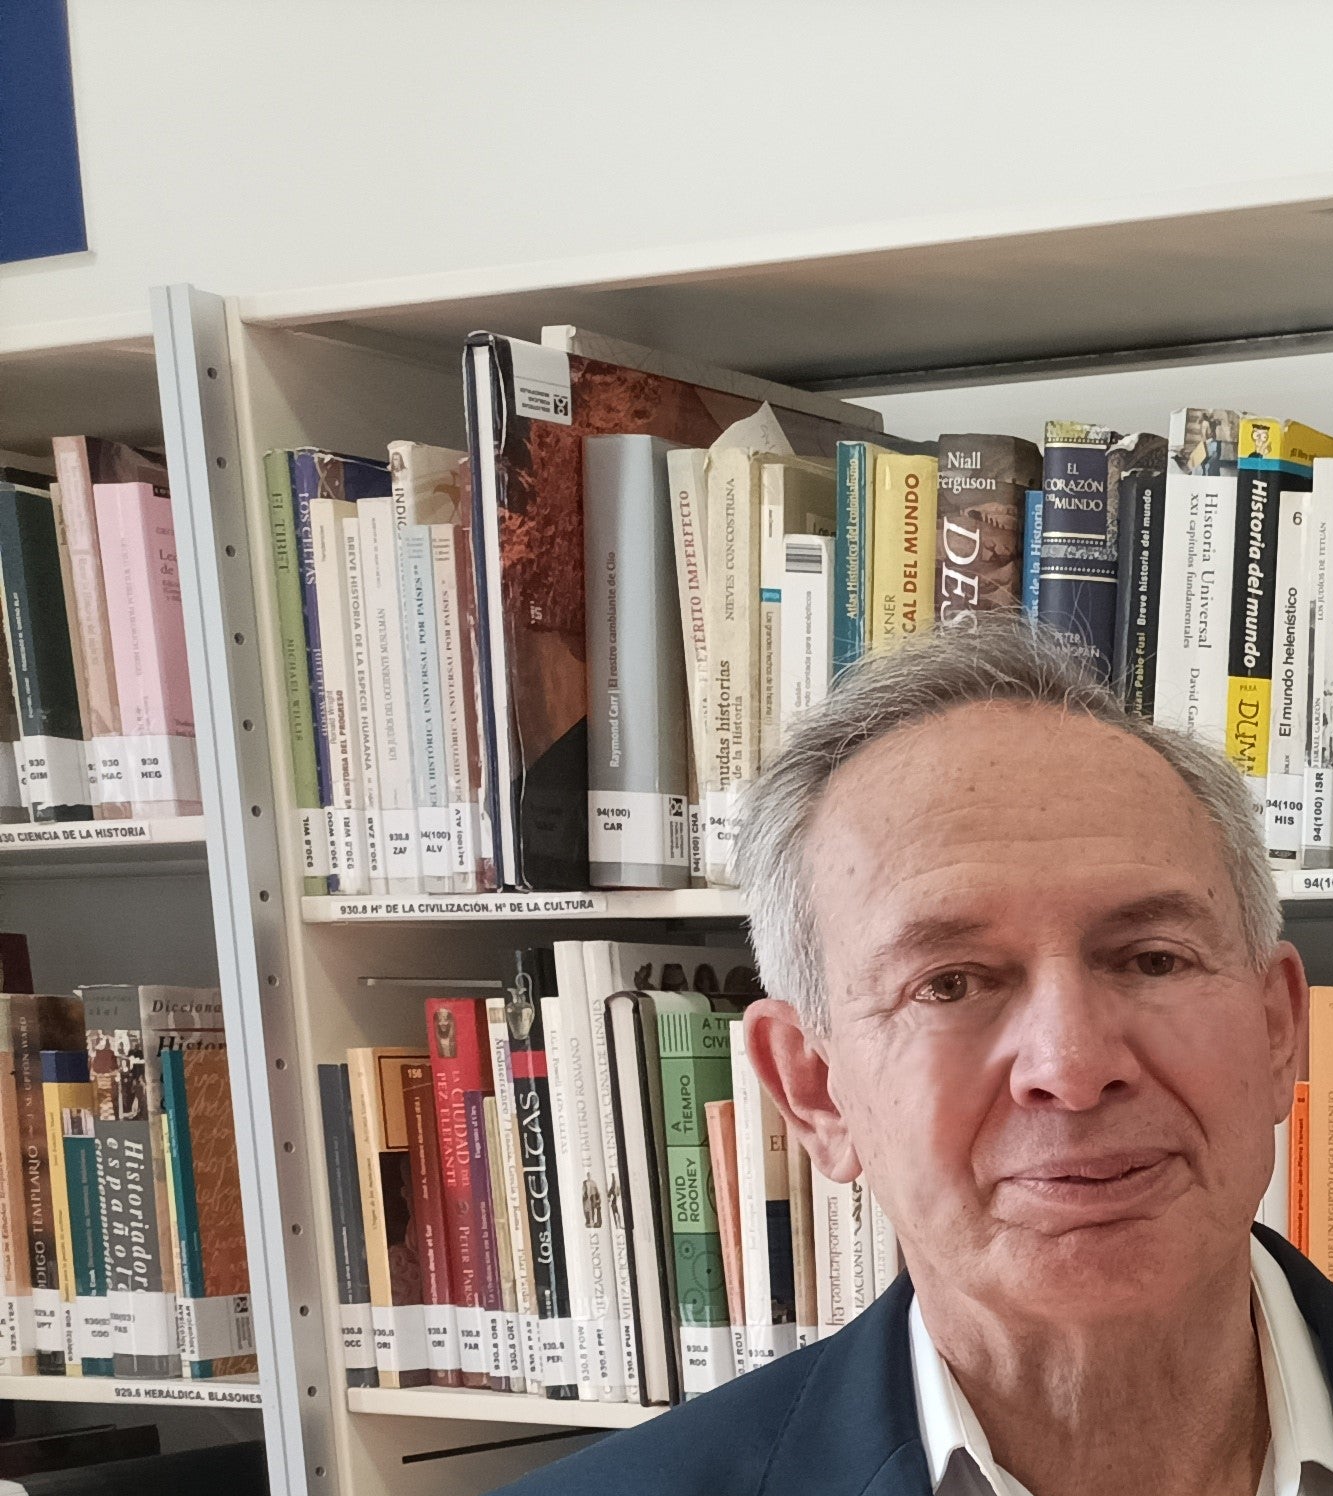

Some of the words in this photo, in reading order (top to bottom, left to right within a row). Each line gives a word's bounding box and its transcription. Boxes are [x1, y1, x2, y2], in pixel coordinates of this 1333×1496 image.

[1248, 478, 1268, 559] Historia
[1247, 564, 1263, 597] del
[1243, 600, 1261, 669] mundo
[1283, 586, 1299, 666] helenístico
[1280, 668, 1293, 719] mundo
[1279, 722, 1291, 736] El
[675, 1176, 687, 1222] DAVID
[686, 1157, 700, 1222] ROONEY
